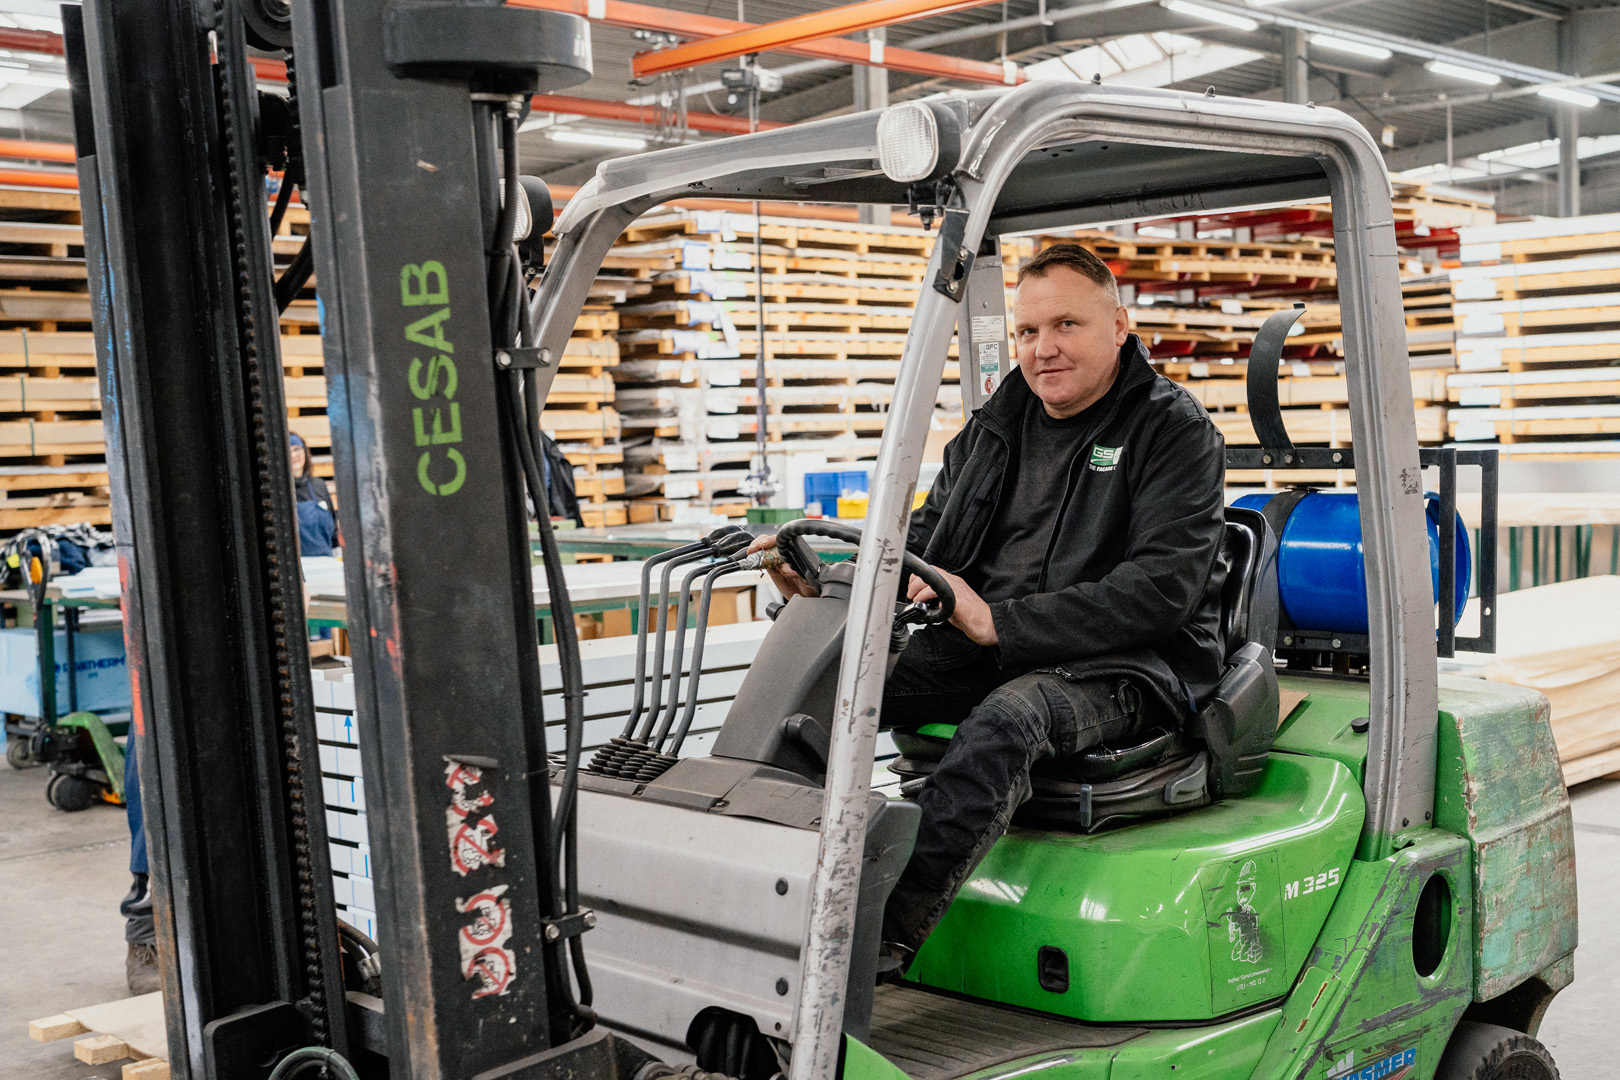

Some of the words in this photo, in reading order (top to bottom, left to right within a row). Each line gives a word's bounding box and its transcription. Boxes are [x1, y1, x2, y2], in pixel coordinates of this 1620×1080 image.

[401, 260, 467, 496] CESAB
[1284, 880, 1300, 901] M
[1302, 867, 1340, 895] 325
